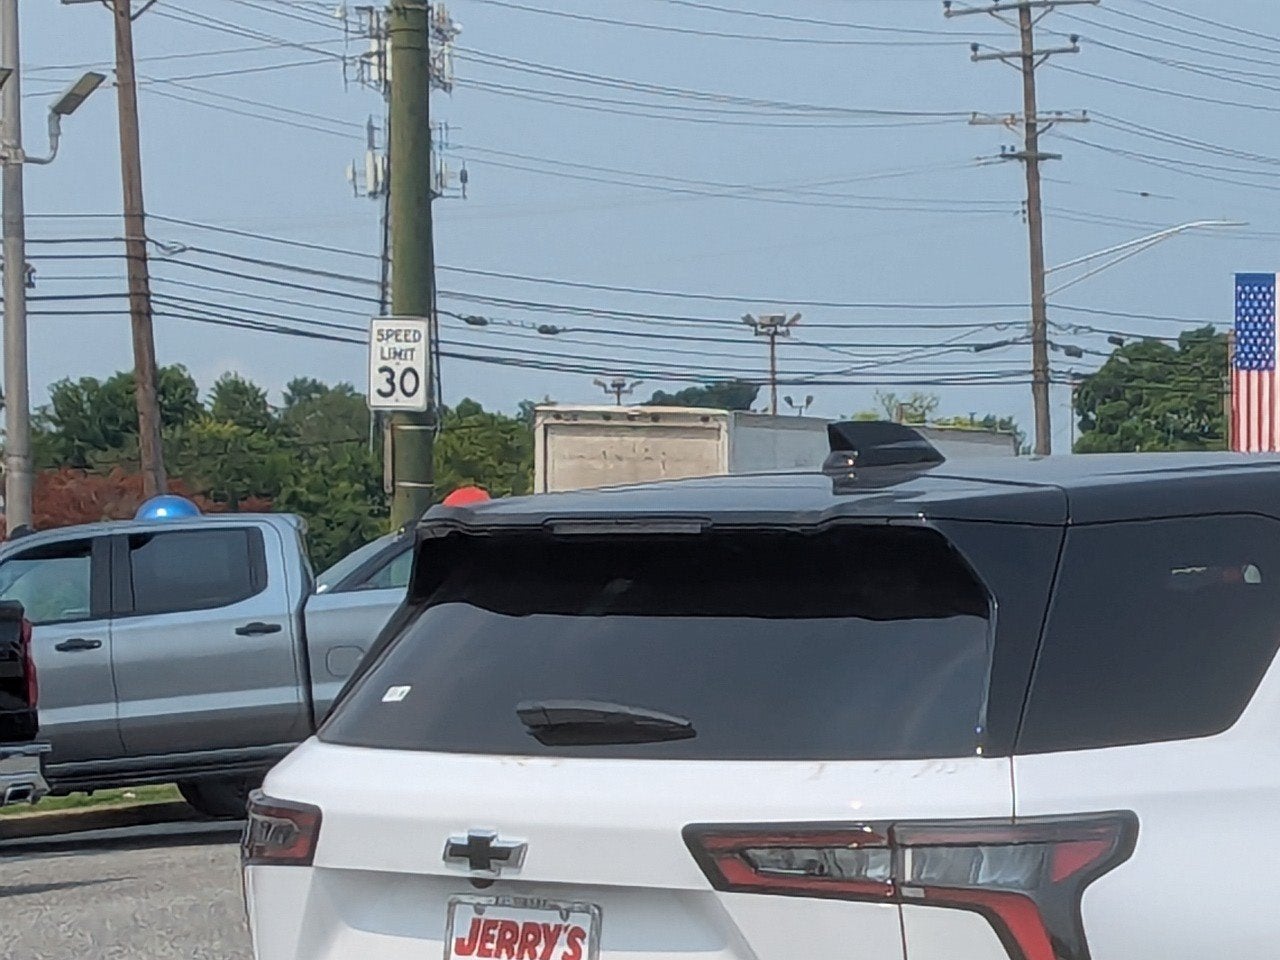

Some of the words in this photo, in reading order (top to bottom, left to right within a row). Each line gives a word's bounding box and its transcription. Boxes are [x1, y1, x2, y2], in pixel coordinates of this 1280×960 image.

[376, 328, 422, 343] SPEED
[380, 346, 415, 360] LIMIT
[376, 365, 420, 398] 30
